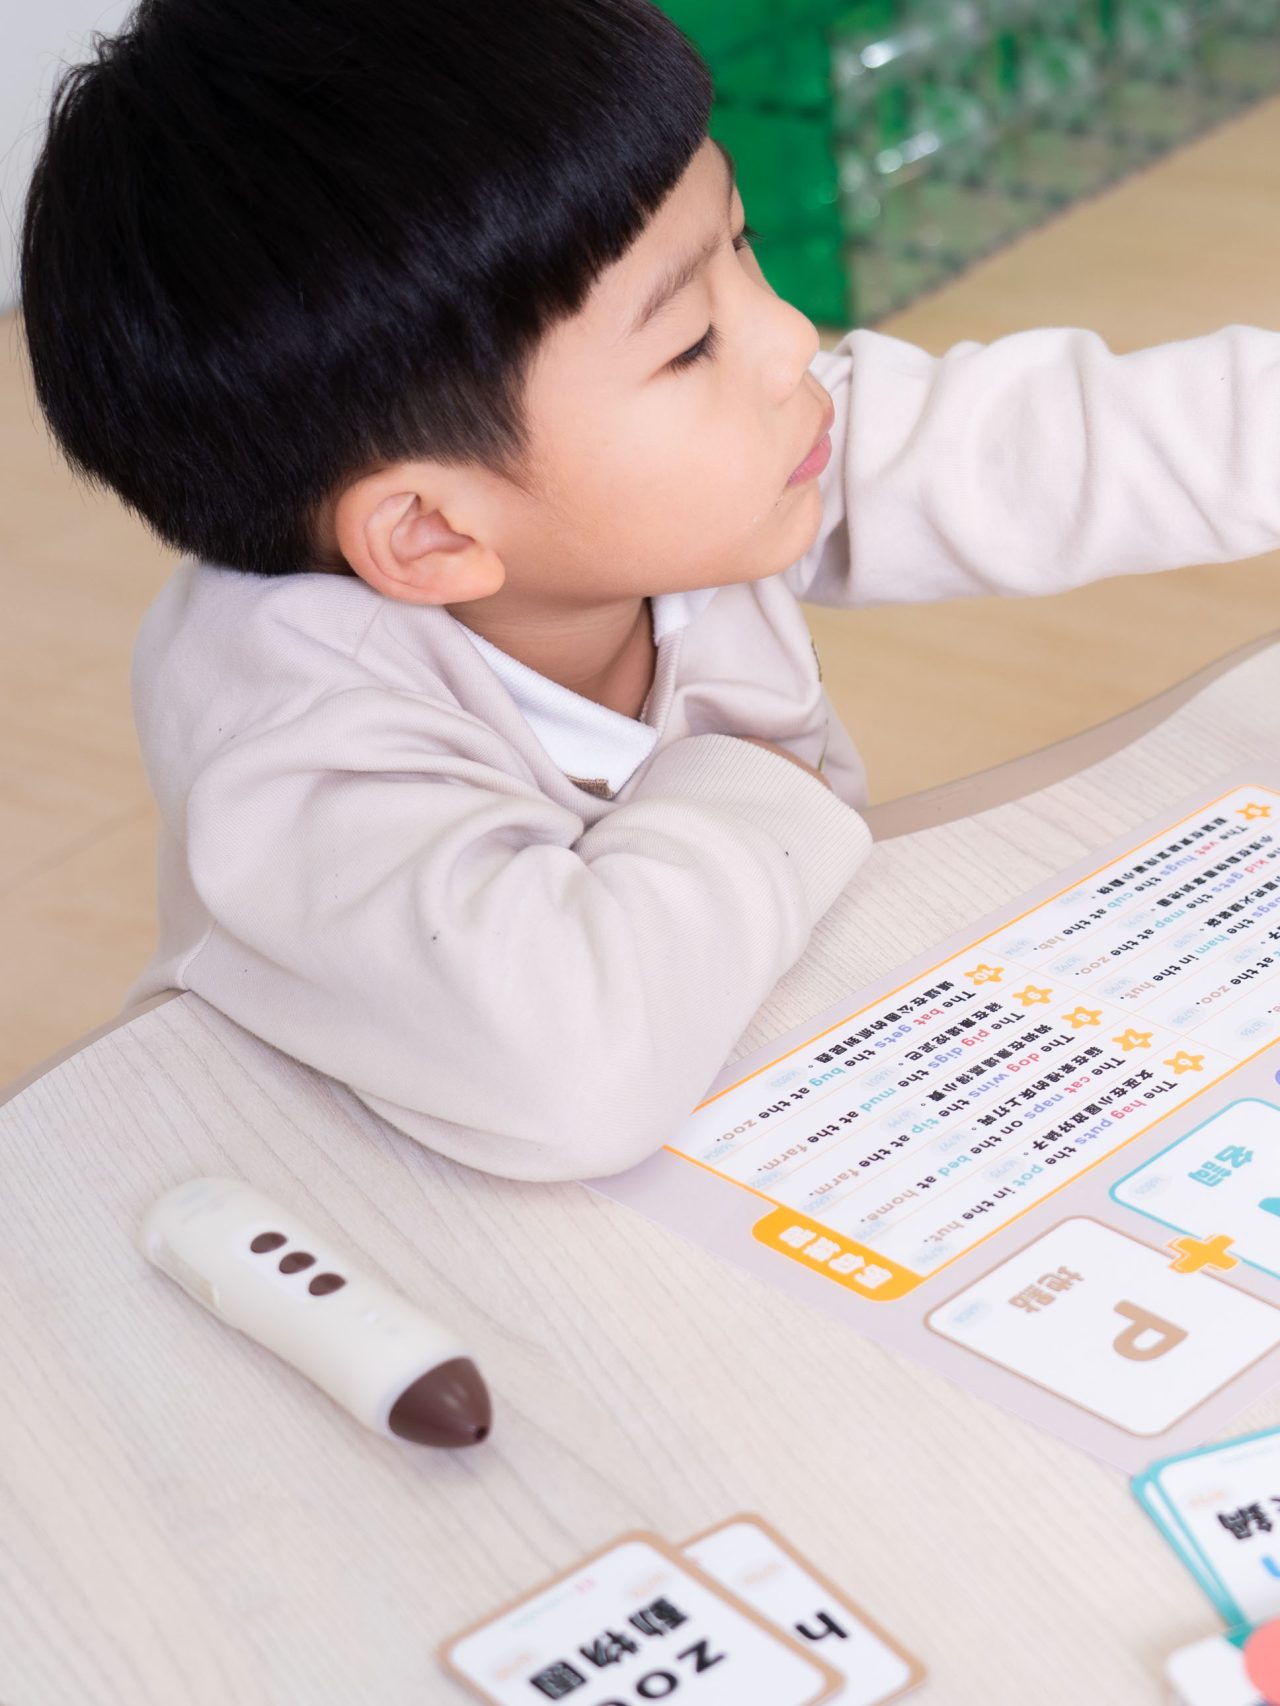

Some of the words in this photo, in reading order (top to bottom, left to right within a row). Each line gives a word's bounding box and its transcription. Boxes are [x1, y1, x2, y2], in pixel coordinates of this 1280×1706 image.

[1219, 825, 1249, 841] The
[1194, 841, 1218, 856] vet
[1159, 855, 1198, 876] hugs
[1244, 858, 1269, 874] kid
[1134, 876, 1162, 892] the
[1210, 871, 1244, 893] gets
[1106, 892, 1134, 909] cub
[1185, 893, 1214, 909] the
[1089, 908, 1107, 920] at
[1154, 909, 1186, 929] map
[1062, 919, 1092, 935] the
[1136, 928, 1155, 940] at
[1226, 918, 1255, 935] the
[1032, 935, 1066, 951] lab.
[1110, 940, 1140, 956] the
[1194, 934, 1230, 954] ham
[1074, 955, 1111, 976] zoo.
[1178, 954, 1199, 965] in
[1255, 956, 1274, 969] at
[1152, 965, 1182, 982] the
[1229, 968, 1260, 985] the
[942, 990, 977, 1008] The
[1119, 981, 1157, 1000] hut.
[1195, 984, 1231, 1006] zoo.
[912, 1008, 945, 1026] bat
[990, 1012, 1026, 1030] The
[873, 1024, 913, 1049] gets
[960, 1028, 991, 1047] pig
[1040, 1034, 1076, 1053] The
[844, 1049, 876, 1067] the
[927, 1047, 963, 1069] digs
[1006, 1052, 1040, 1073] dog
[1091, 1057, 1126, 1076] The
[808, 1067, 846, 1087] bug
[897, 1069, 930, 1088] the
[967, 1073, 1010, 1098] wins
[1063, 1076, 1091, 1094] cat
[789, 1087, 811, 1100] at
[1143, 1080, 1179, 1099] The
[758, 1100, 792, 1119] the
[859, 1087, 897, 1113] mud
[938, 1098, 971, 1118] the
[1023, 1093, 1065, 1120] naps
[1110, 1099, 1147, 1120] hag
[838, 1111, 859, 1124] at
[911, 1118, 940, 1134] tip
[715, 1119, 758, 1148] zoo.
[807, 1124, 841, 1143] the
[999, 1120, 1024, 1135] on
[1074, 1118, 1113, 1145] puts
[889, 1134, 911, 1148] at
[969, 1135, 1003, 1155] the
[756, 1143, 808, 1179] farm.
[858, 1148, 892, 1168] the
[1044, 1146, 1077, 1165] the
[937, 1154, 973, 1177] bed
[1012, 1163, 1045, 1187] pot
[1187, 1145, 1254, 1188] 名詞
[808, 1168, 860, 1204] farm.
[916, 1175, 937, 1189] at
[992, 1186, 1016, 1199] in
[860, 1189, 920, 1227] home.
[961, 1200, 996, 1220] the
[922, 1220, 965, 1244] hut.
[1007, 1265, 1084, 1314] 地點
[1112, 1299, 1189, 1362] P
[594, 1638, 726, 1706] zo
